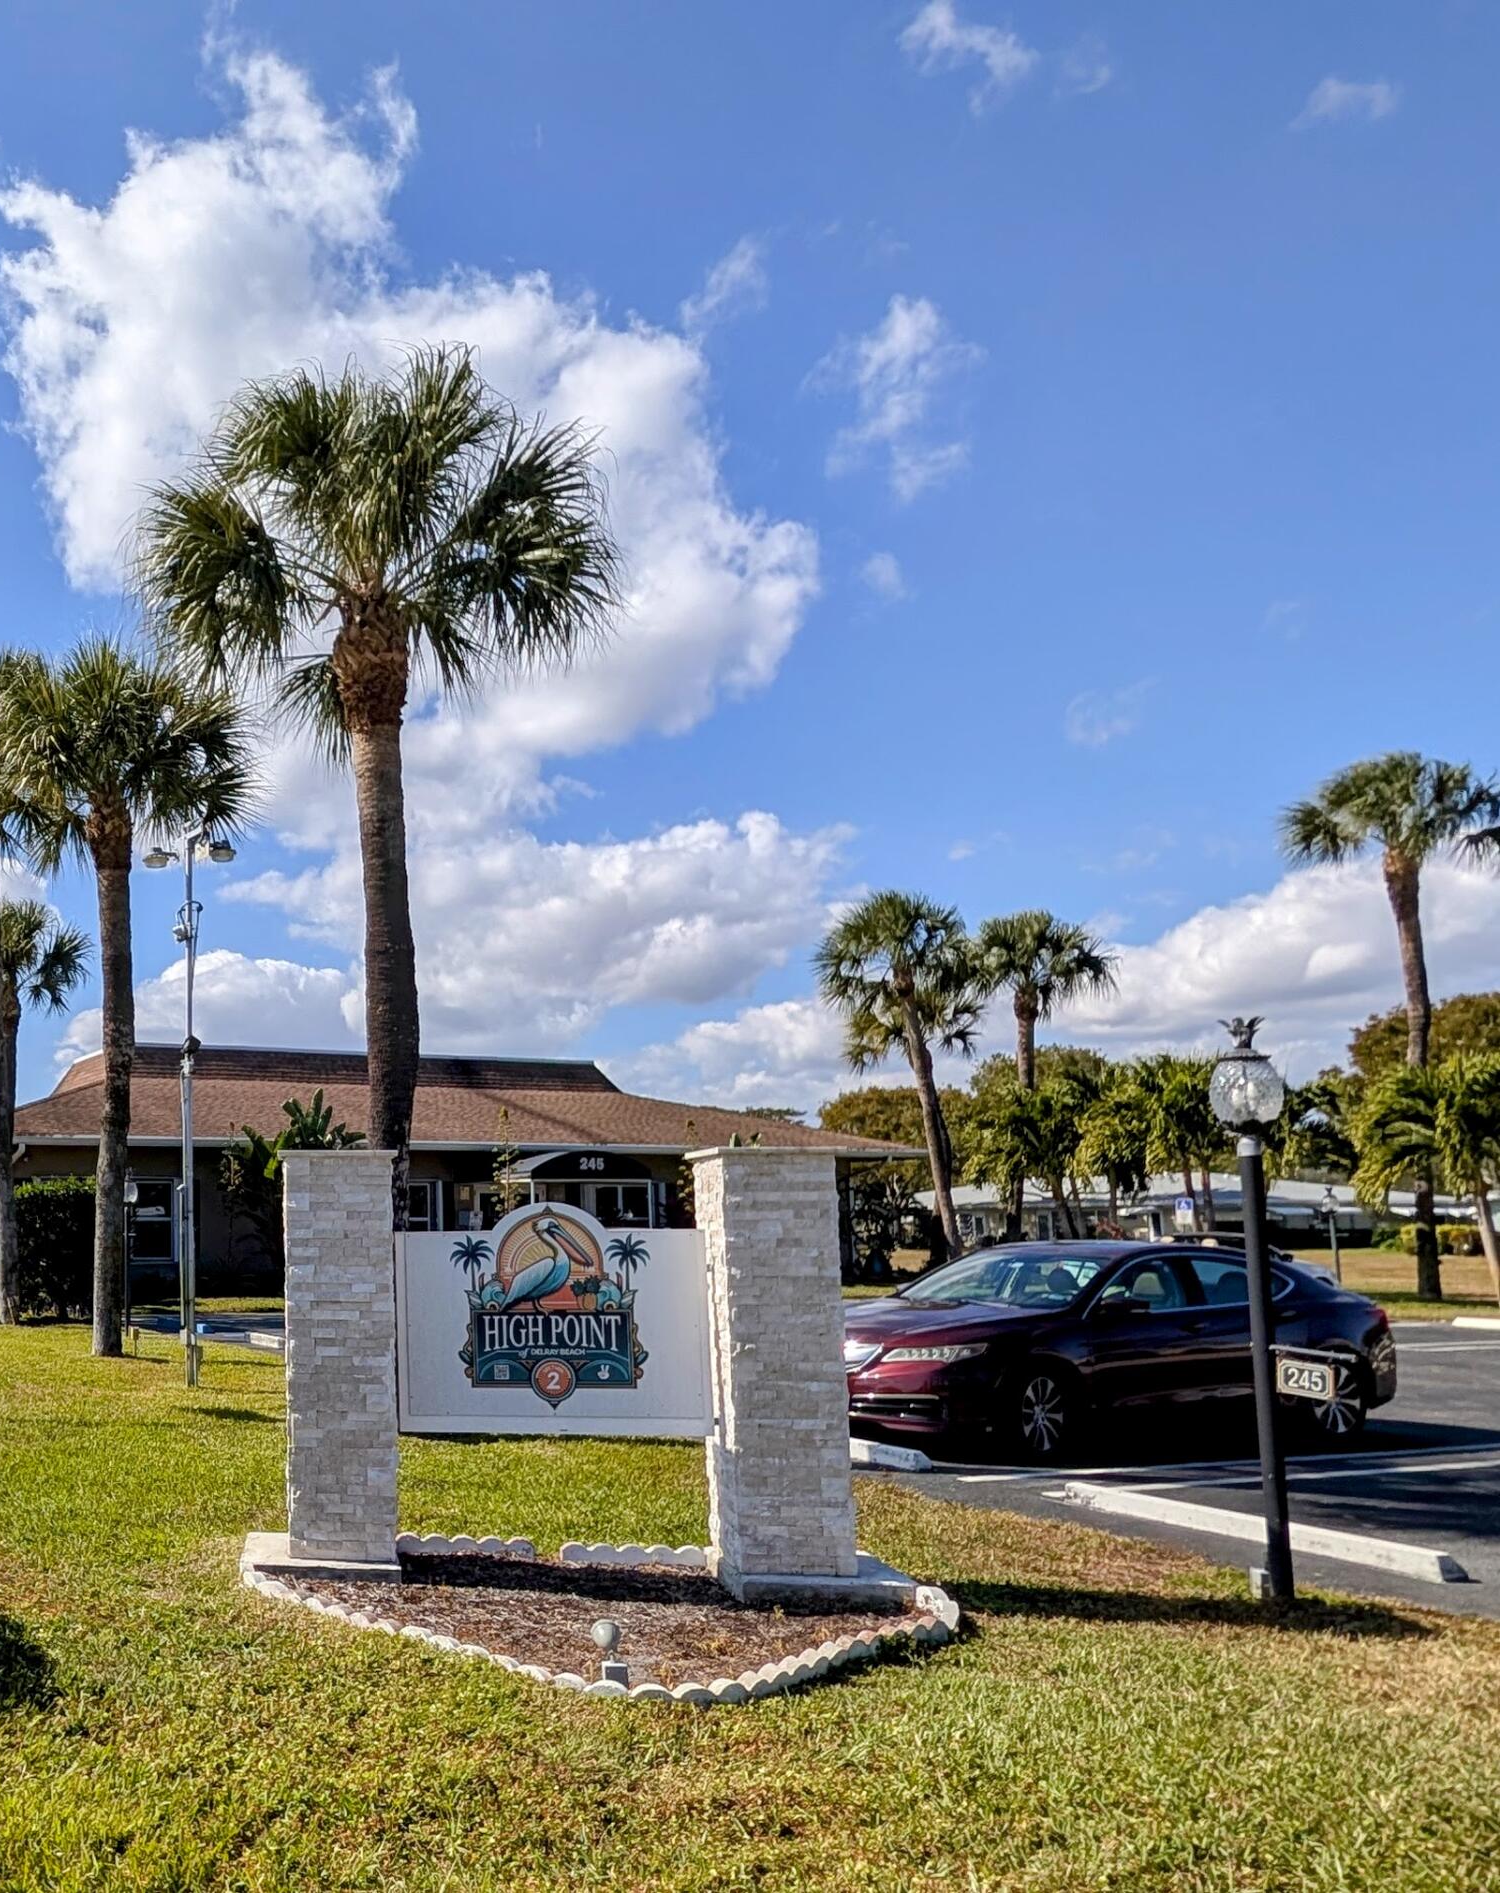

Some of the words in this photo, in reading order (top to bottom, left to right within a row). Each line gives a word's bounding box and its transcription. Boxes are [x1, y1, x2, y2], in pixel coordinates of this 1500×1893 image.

[579, 1157, 605, 1171] 245
[482, 1314, 545, 1352] HIGH
[550, 1315, 622, 1351] POINT
[518, 1347, 530, 1359] of
[530, 1348, 559, 1356] DELRAY
[546, 1371, 561, 1390] 2
[1287, 1367, 1323, 1392] 245
